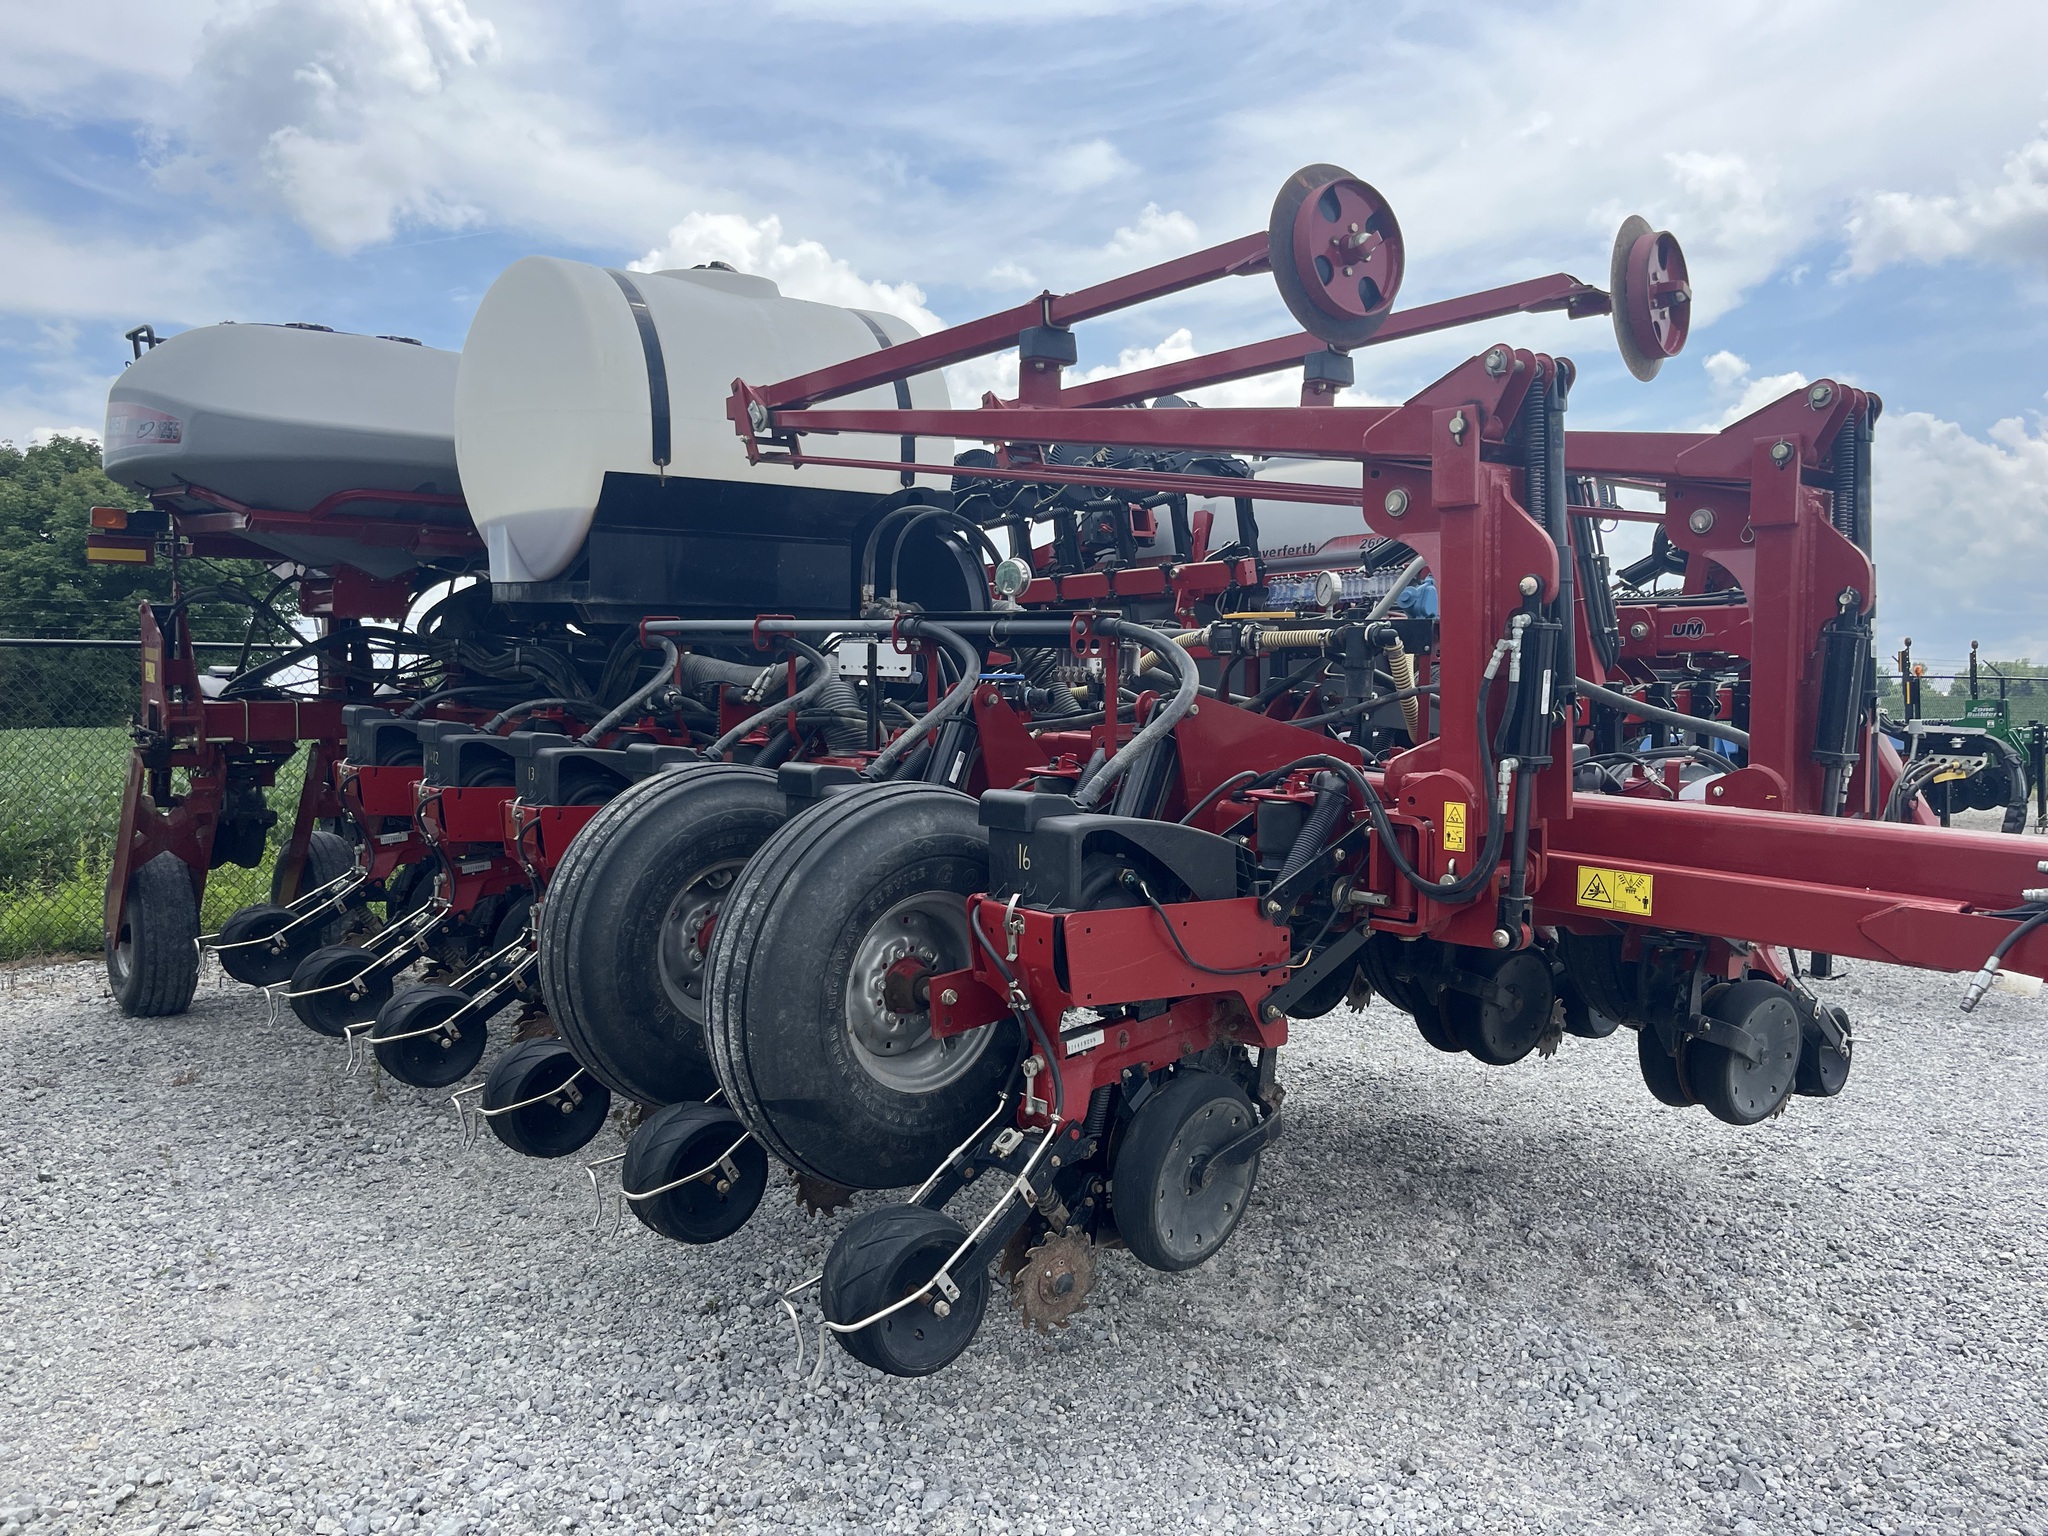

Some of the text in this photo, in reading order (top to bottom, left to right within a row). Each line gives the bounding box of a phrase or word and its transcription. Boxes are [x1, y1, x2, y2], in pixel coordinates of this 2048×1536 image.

[1259, 543, 1316, 558] verferth
[1672, 623, 1703, 636] UM
[432, 751, 439, 766] 12
[528, 766, 535, 781] 13
[1018, 843, 1031, 870] 16
